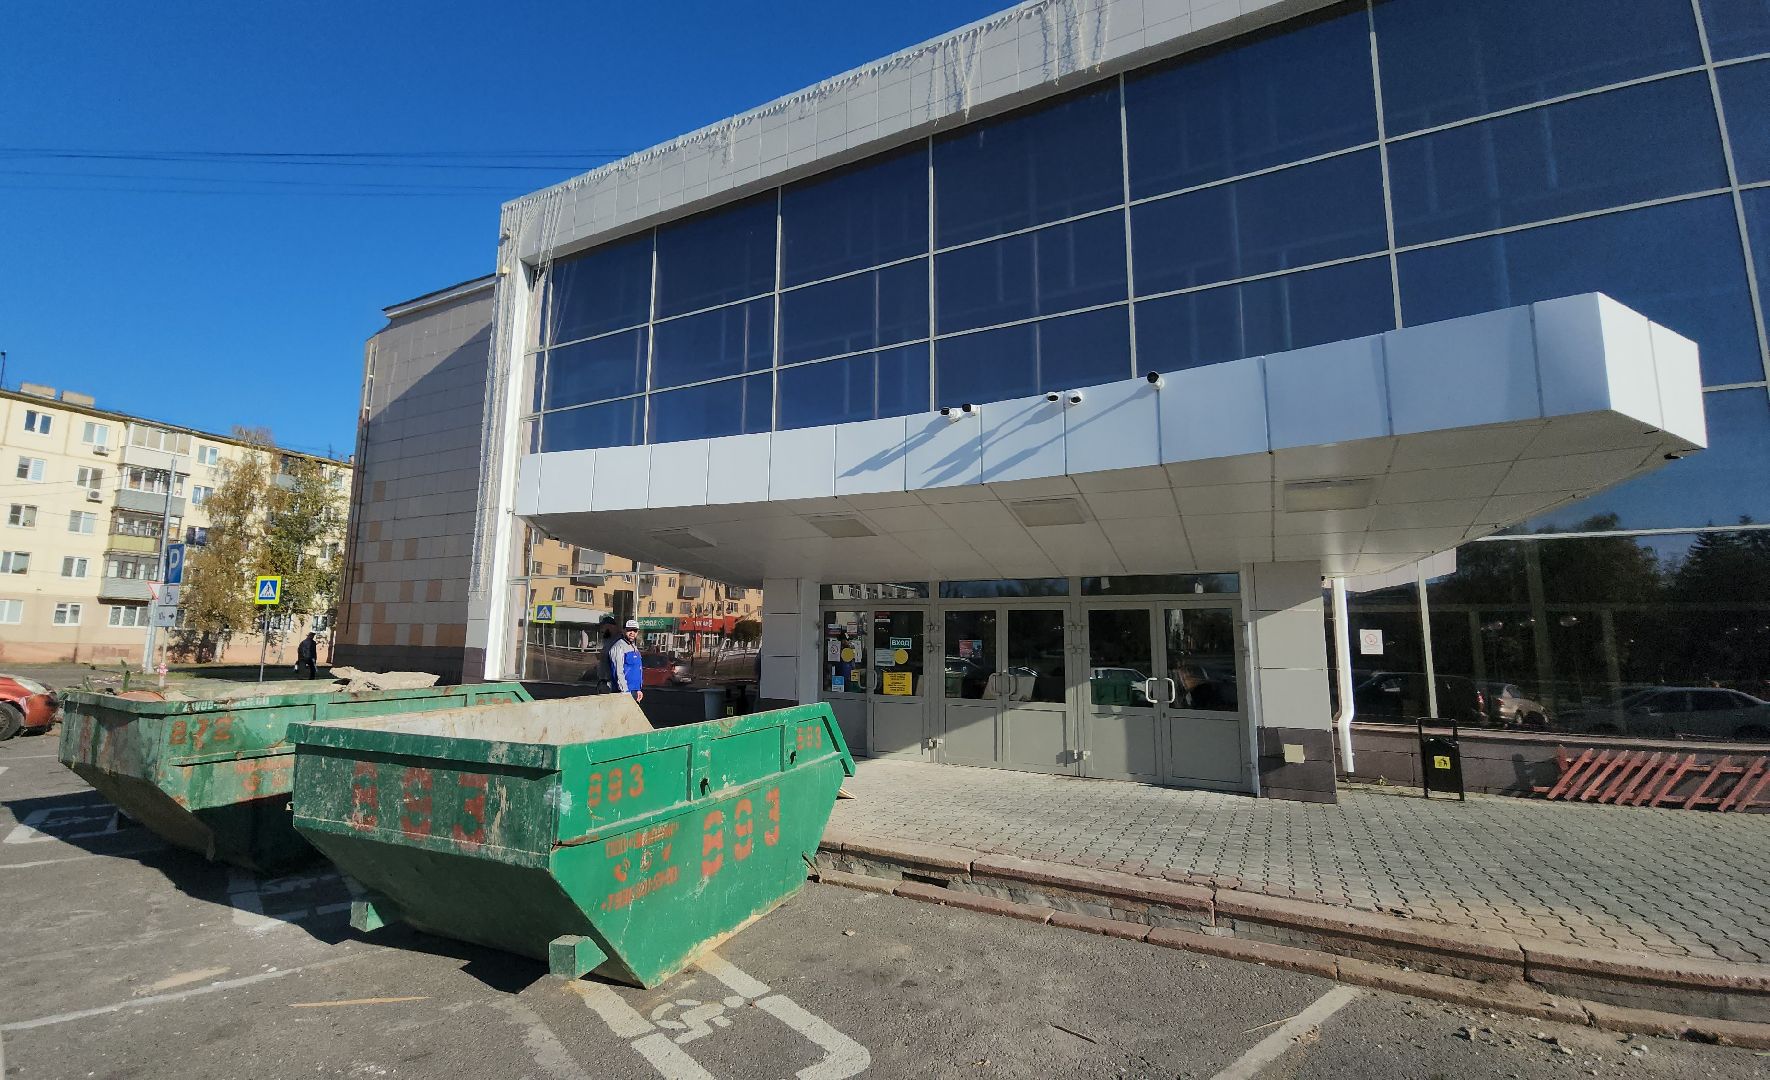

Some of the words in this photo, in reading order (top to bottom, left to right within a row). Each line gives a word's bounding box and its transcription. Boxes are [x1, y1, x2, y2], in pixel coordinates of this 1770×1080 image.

[168, 548, 179, 579] P
[351, 761, 489, 851] 893
[588, 763, 644, 807] 893
[701, 787, 781, 877] 893
